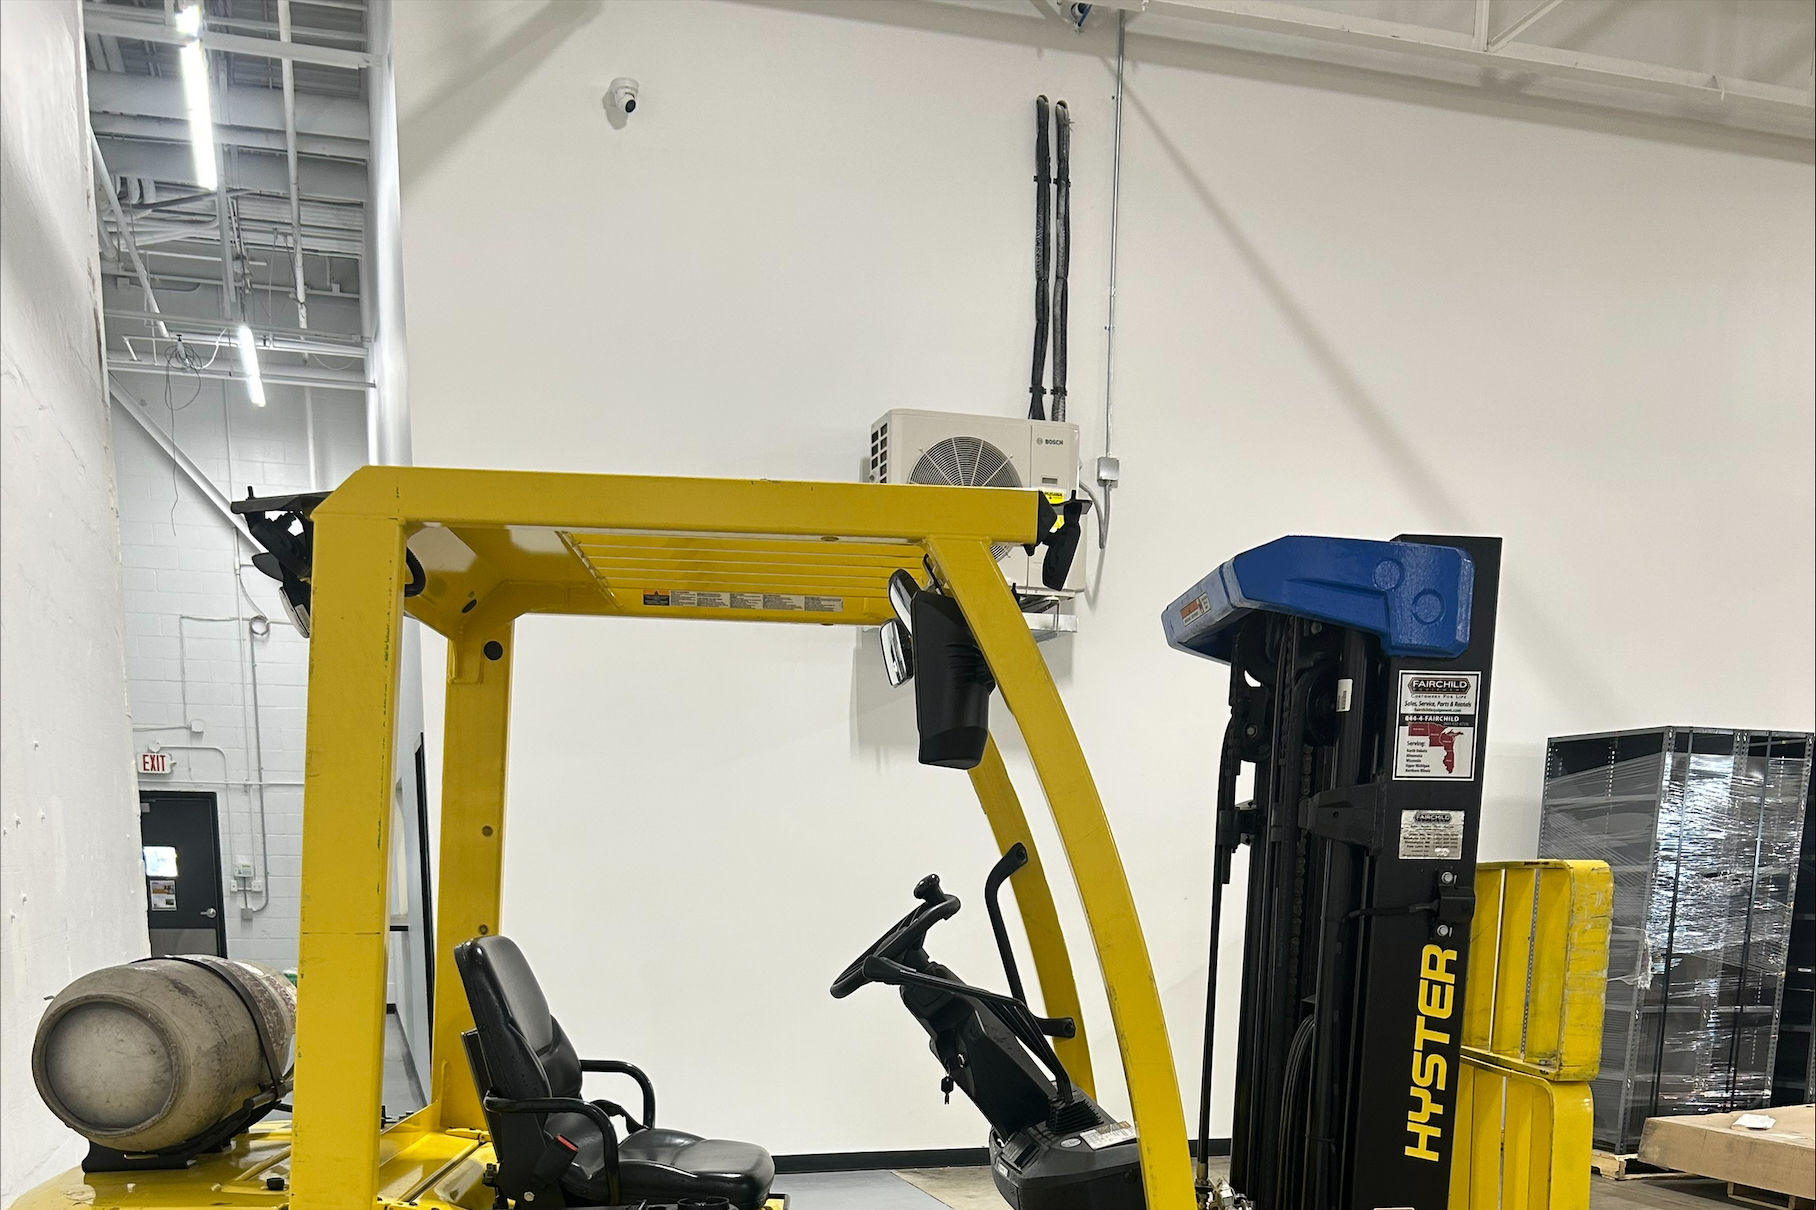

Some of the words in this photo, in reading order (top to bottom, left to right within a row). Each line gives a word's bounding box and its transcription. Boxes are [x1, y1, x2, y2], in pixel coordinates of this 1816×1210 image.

[1412, 680, 1468, 688] FAIRCHILD
[142, 754, 166, 772] EXIT
[1404, 943, 1458, 1163] HYSTER
